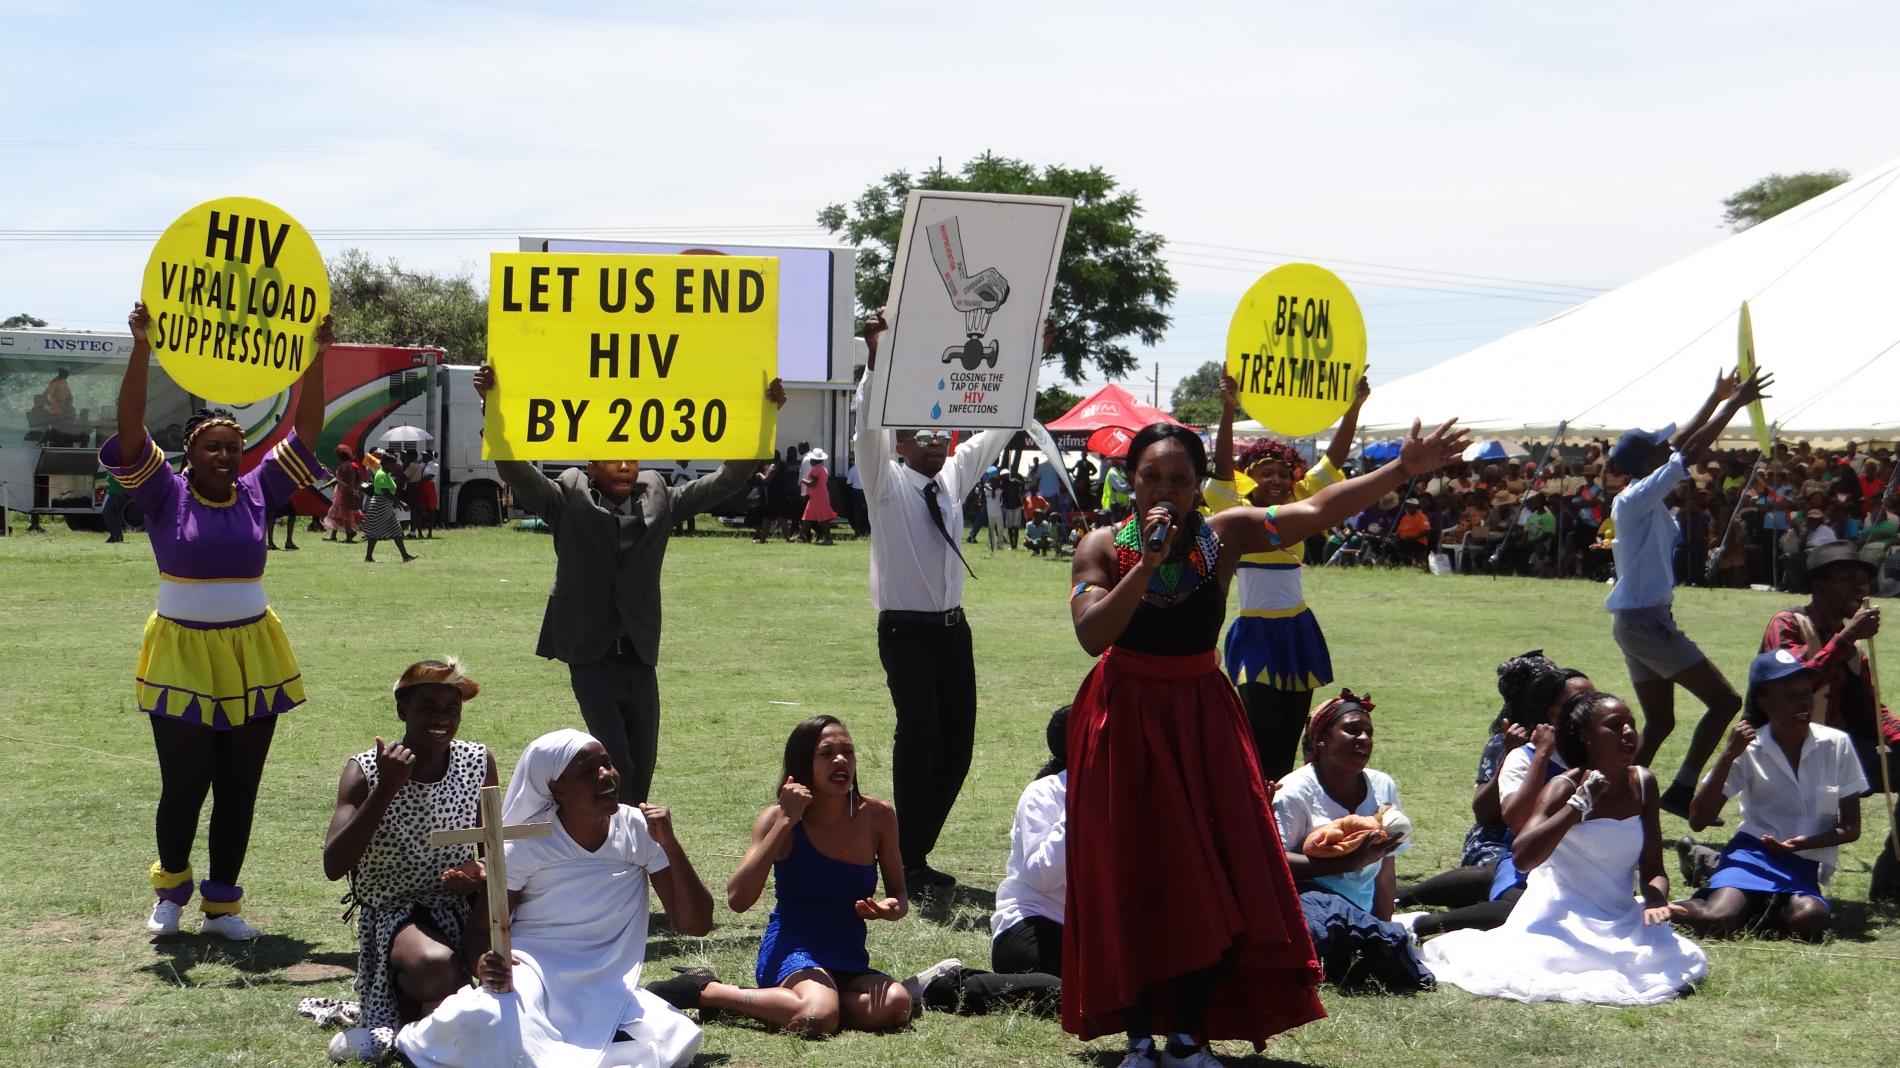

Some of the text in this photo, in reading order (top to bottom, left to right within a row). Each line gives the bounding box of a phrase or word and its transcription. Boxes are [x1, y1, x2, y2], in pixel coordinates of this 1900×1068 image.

[205, 210, 291, 268] HIV
[161, 261, 317, 324] VIRAL LOAD
[502, 266, 765, 314] LET US END
[1275, 295, 1330, 340] BE ON
[44, 338, 113, 352] INSTEC
[155, 311, 304, 372] SUPPRESSION
[589, 332, 680, 379] HIV
[950, 372, 1004, 382] CLOSING THE
[951, 382, 1001, 391] TAP OF NEW
[963, 391, 985, 404] HIV
[1239, 353, 1352, 402] TREATMENT
[526, 398, 727, 443] BY 2030
[948, 404, 998, 414] INFECTIONS
